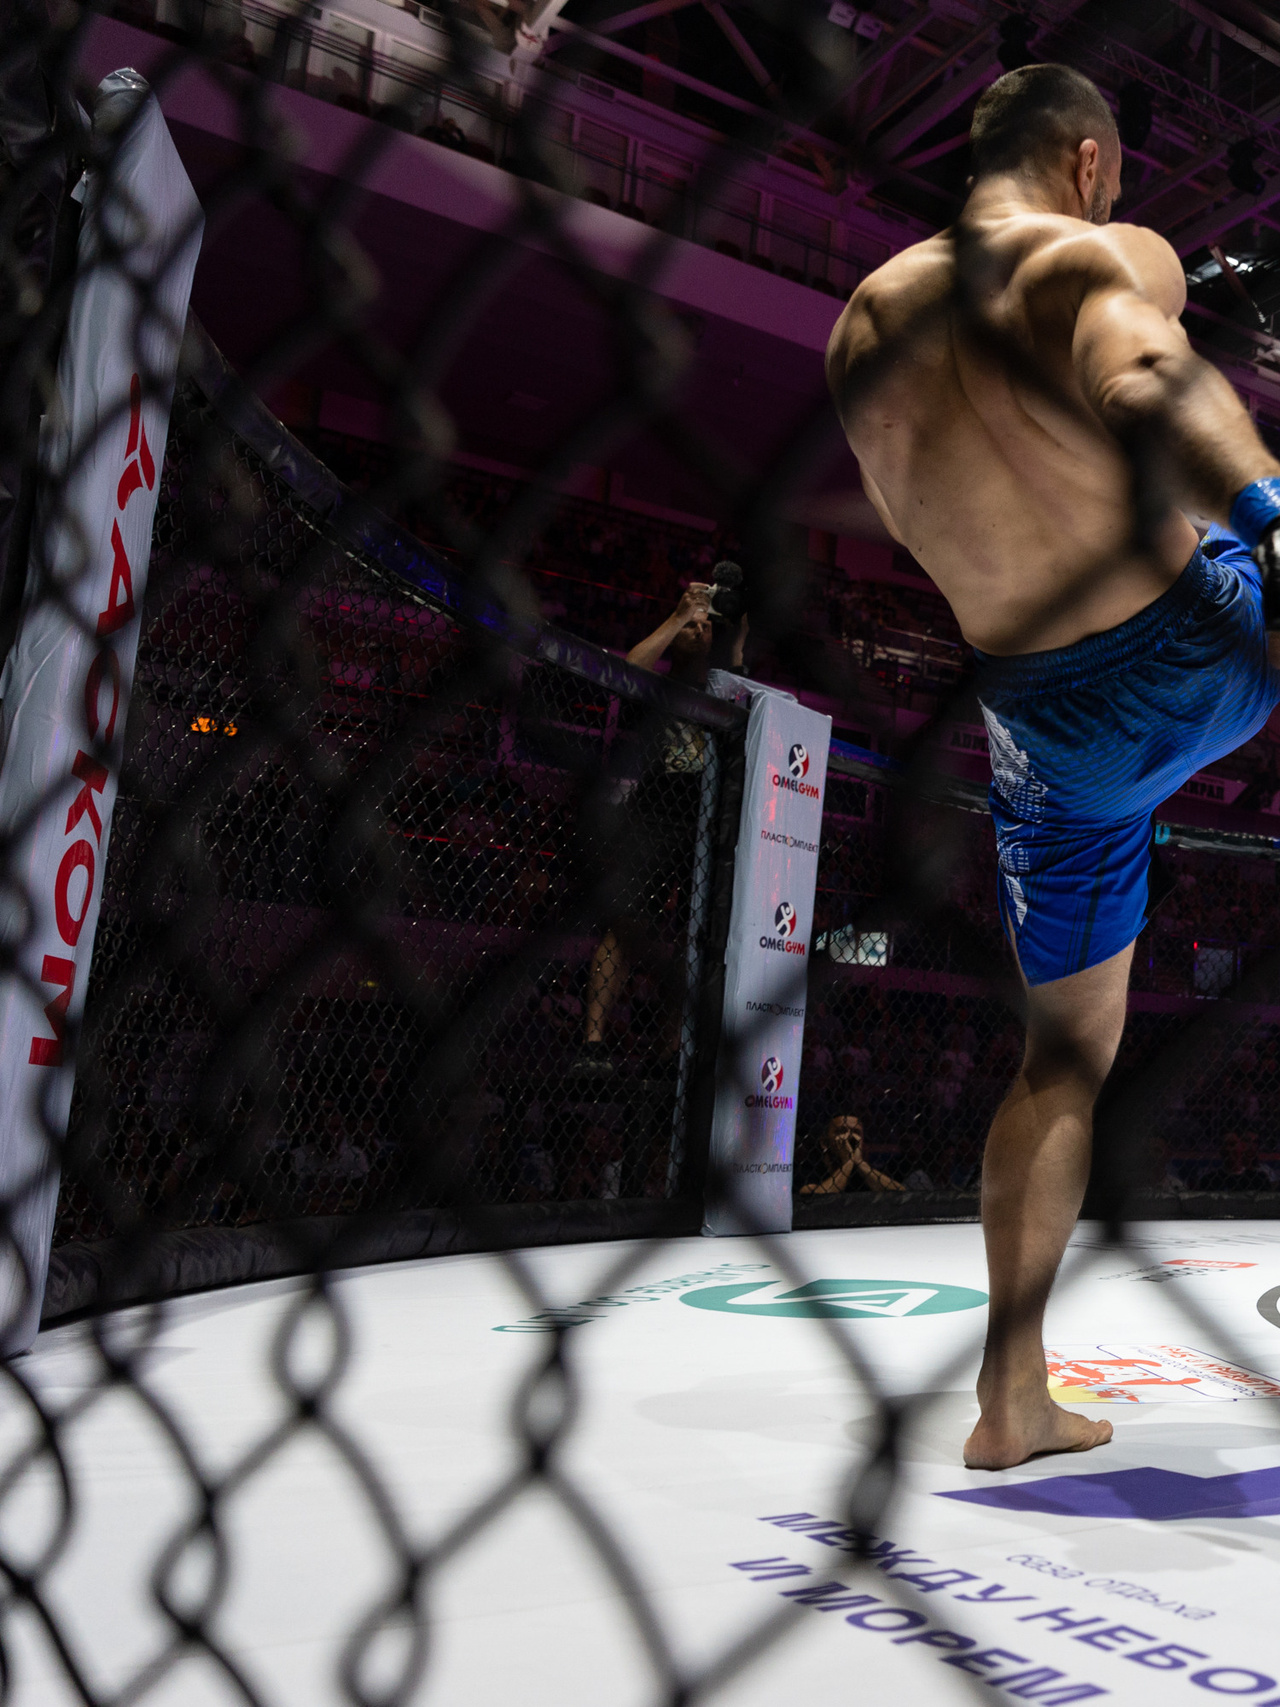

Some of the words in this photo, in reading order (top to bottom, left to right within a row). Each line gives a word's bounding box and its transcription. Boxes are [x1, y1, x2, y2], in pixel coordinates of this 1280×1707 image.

[772, 773, 819, 800] OMELGYM
[759, 935, 806, 957] OMELGYM
[744, 1094, 794, 1110] OMELGYM
[1006, 1551, 1085, 1580] база
[1083, 1576, 1217, 1622] отдыха
